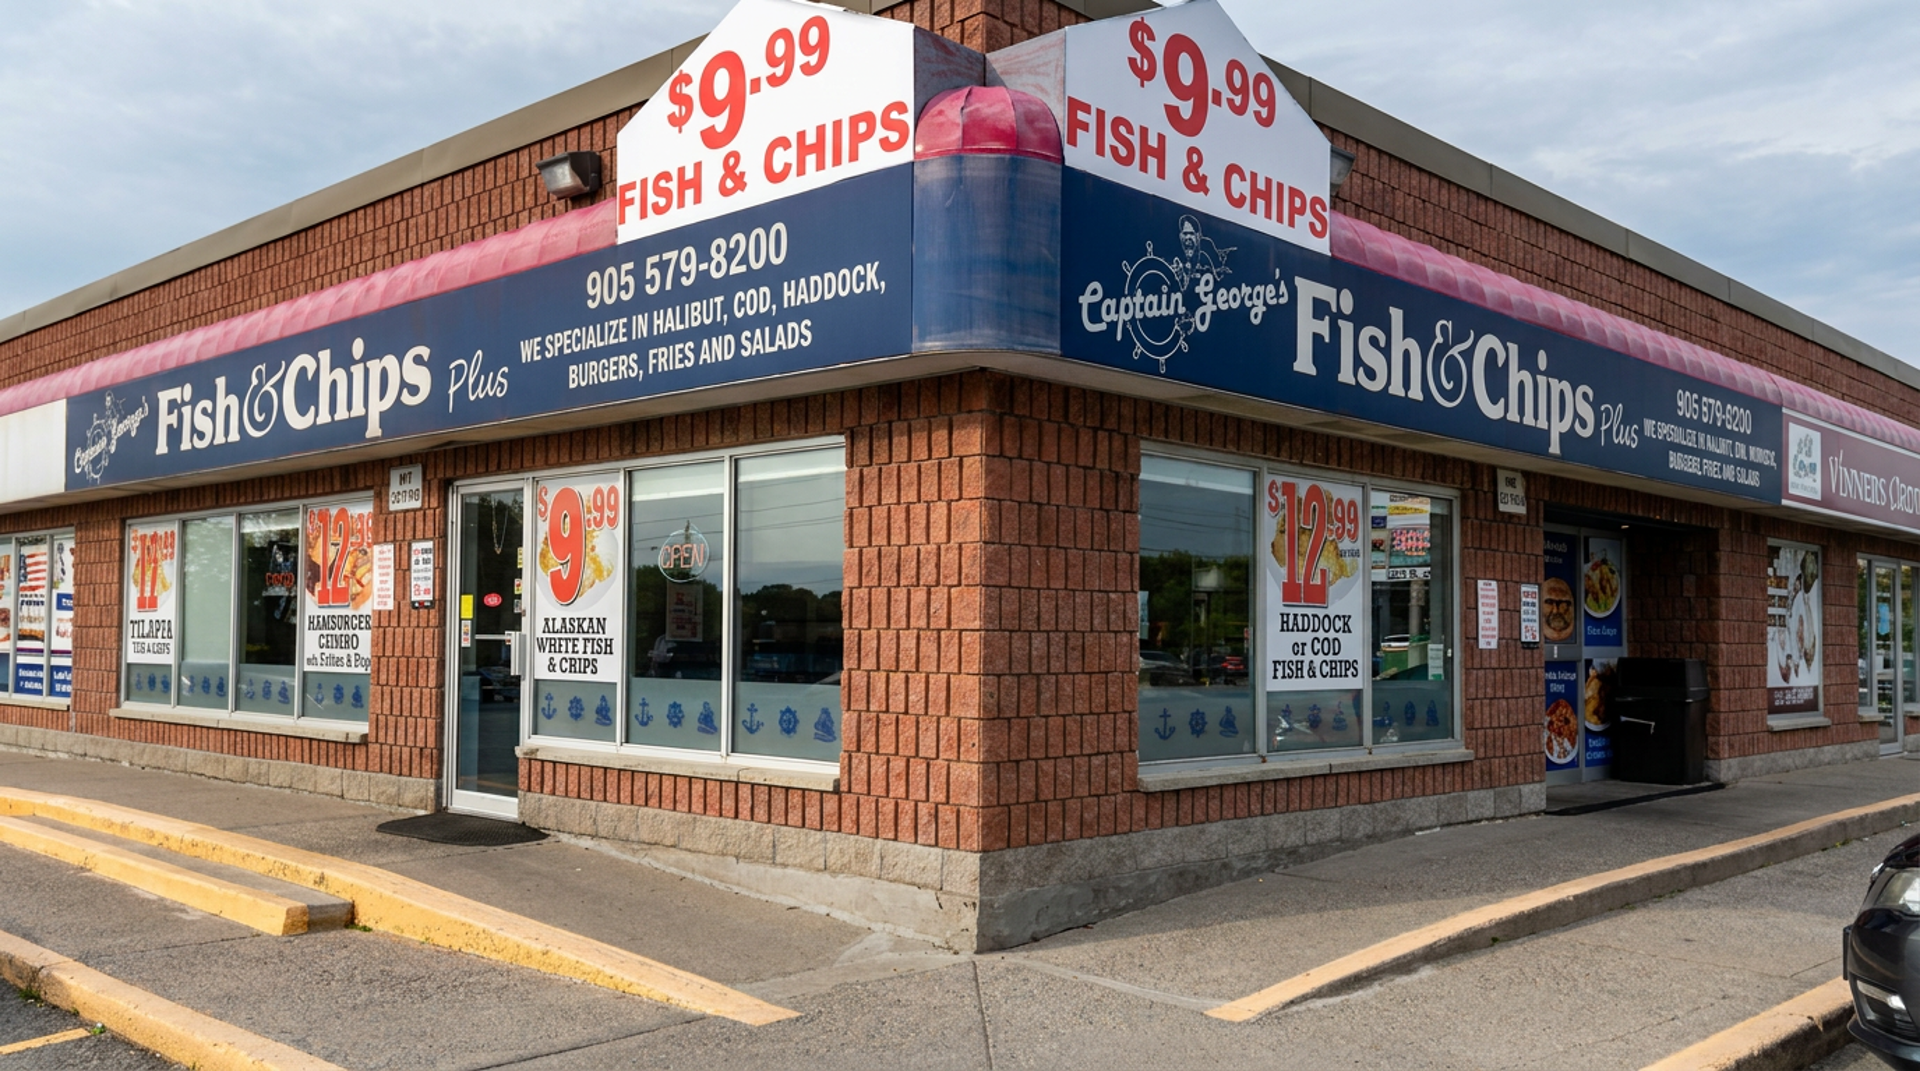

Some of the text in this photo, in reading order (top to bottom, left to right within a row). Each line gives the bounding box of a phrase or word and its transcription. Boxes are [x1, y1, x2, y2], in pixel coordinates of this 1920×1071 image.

[667, 15, 830, 150] $9.99
[1127, 17, 1277, 137] $9.99
[618, 101, 910, 224] FISH & CHIPS
[1066, 96, 1328, 239] FISH & CHIPS
[586, 222, 788, 308] 905 579-8200
[520, 261, 885, 363] WE SPECIALIZE IN HALIBUT, COD, HADDOCK,
[1078, 268, 1289, 341] Captain George's
[448, 349, 509, 413] Plus
[569, 319, 812, 389] BURGERS, FRIES AND SALADS
[1600, 403, 1639, 448] Plus
[542, 617, 607, 635] ALASKAN
[1279, 612, 1352, 634] HADDOCK
[1311, 636, 1342, 656] COD
[547, 656, 557, 673] &
[1272, 659, 1304, 680] FISH
[1307, 659, 1317, 679] &
